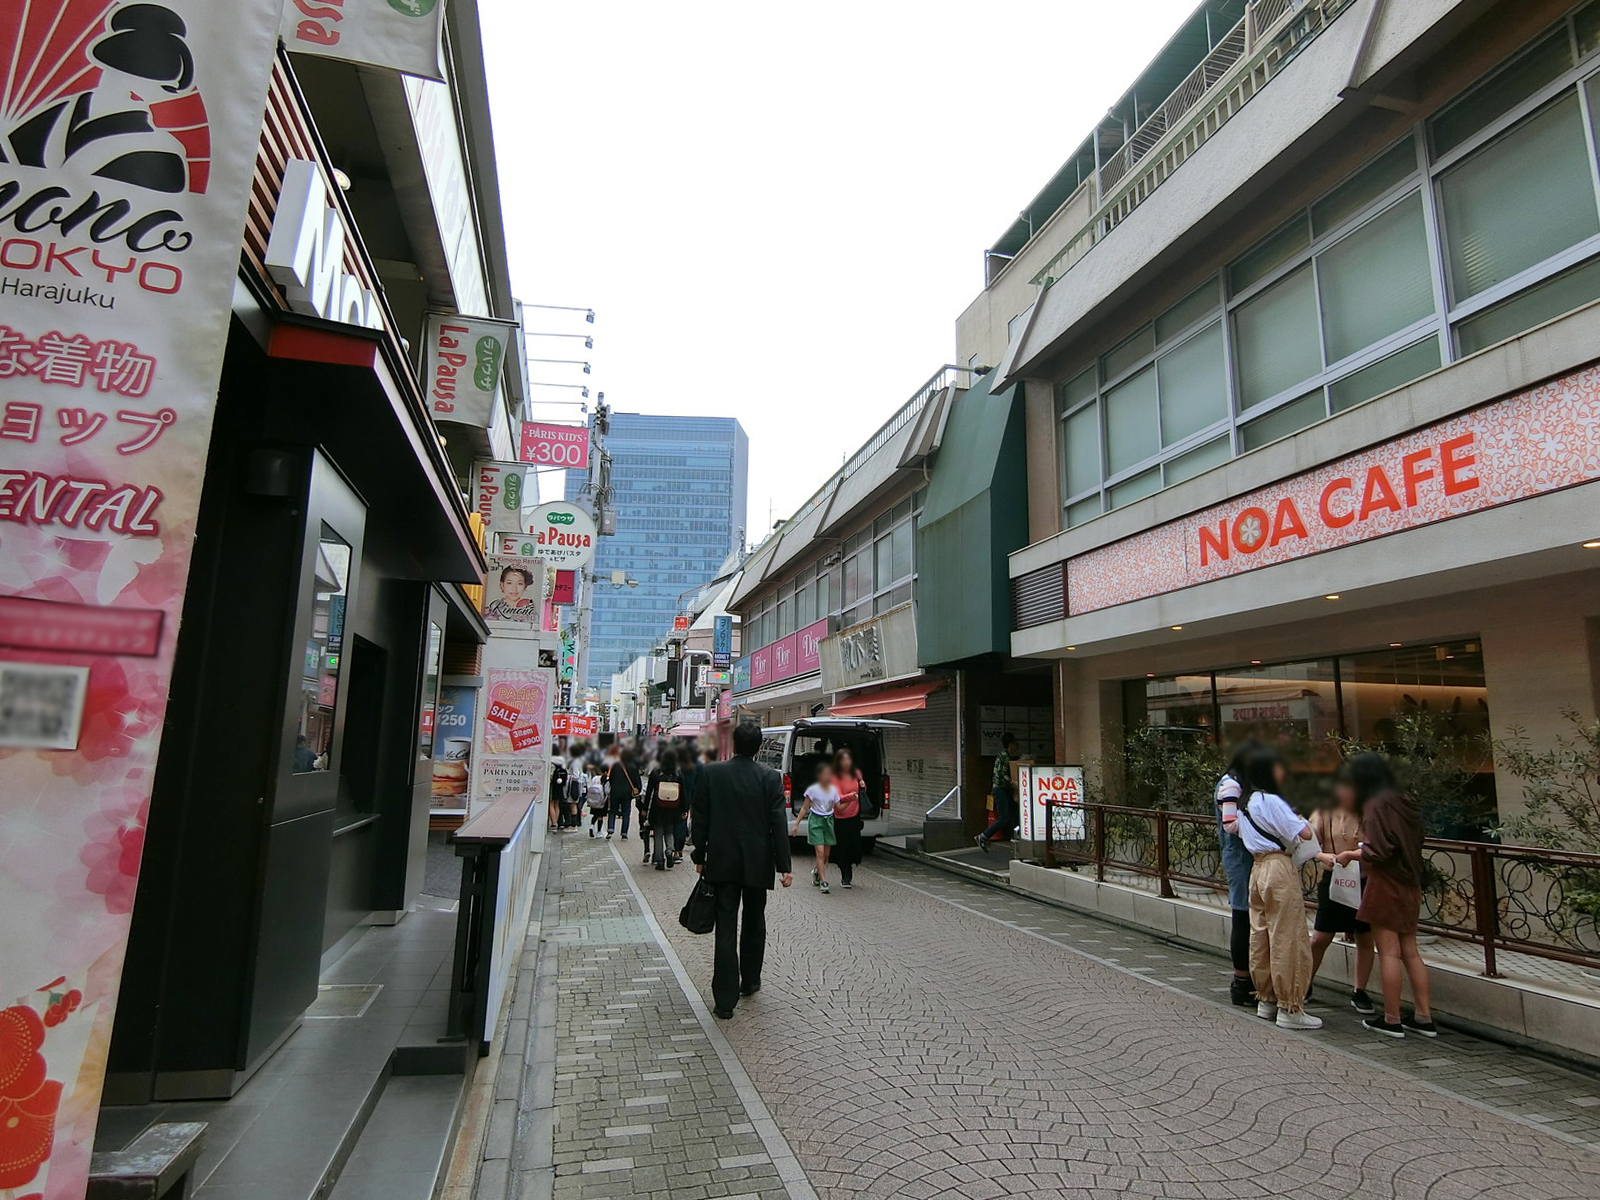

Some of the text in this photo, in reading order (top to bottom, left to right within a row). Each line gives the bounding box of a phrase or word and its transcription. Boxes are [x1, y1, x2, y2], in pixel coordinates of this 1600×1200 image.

[1, 276, 115, 310] Harajuku
[438, 324, 470, 349] La
[431, 351, 467, 414] Pausa
[528, 428, 583, 443] PARIS KID'S
[526, 441, 581, 465] ¥300
[480, 467, 500, 483] La
[1199, 432, 1480, 567] NOA CAFE
[548, 526, 591, 548] Pausa
[499, 687, 539, 700] PARIS
[491, 705, 518, 724] SALE
[1038, 776, 1077, 791] NOA
